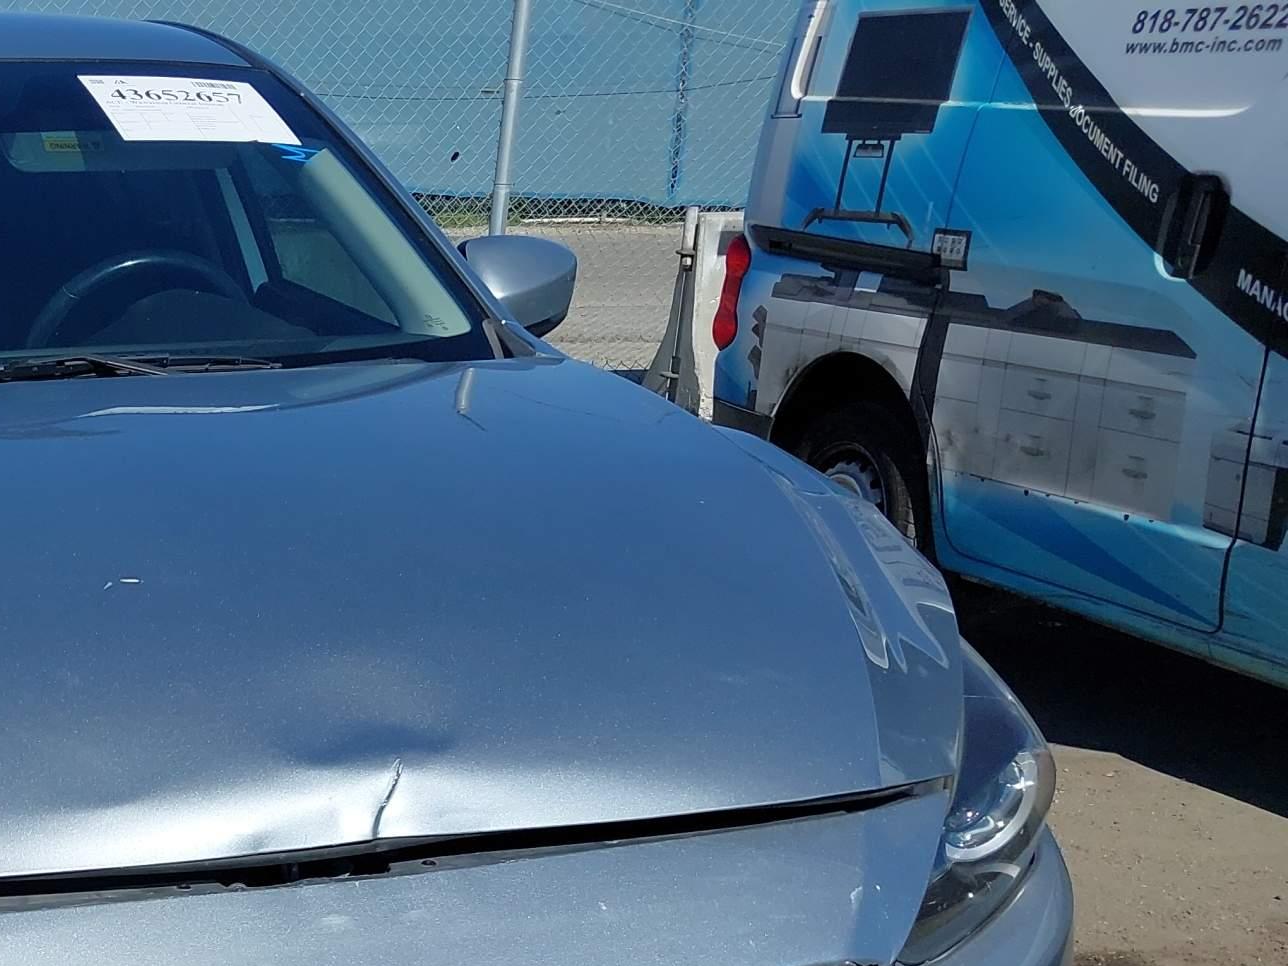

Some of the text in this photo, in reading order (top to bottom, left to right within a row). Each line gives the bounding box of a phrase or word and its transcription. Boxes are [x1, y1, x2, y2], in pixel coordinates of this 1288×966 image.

[1131, 3, 1288, 34] 818-787-2622
[1125, 36, 1283, 55] www.bmc-inc.com
[111, 88, 242, 104] 43652657
[1033, 42, 1072, 108] SUPPLIES
[1069, 104, 1124, 169] DOCUMENT
[1122, 158, 1160, 204] FILING
